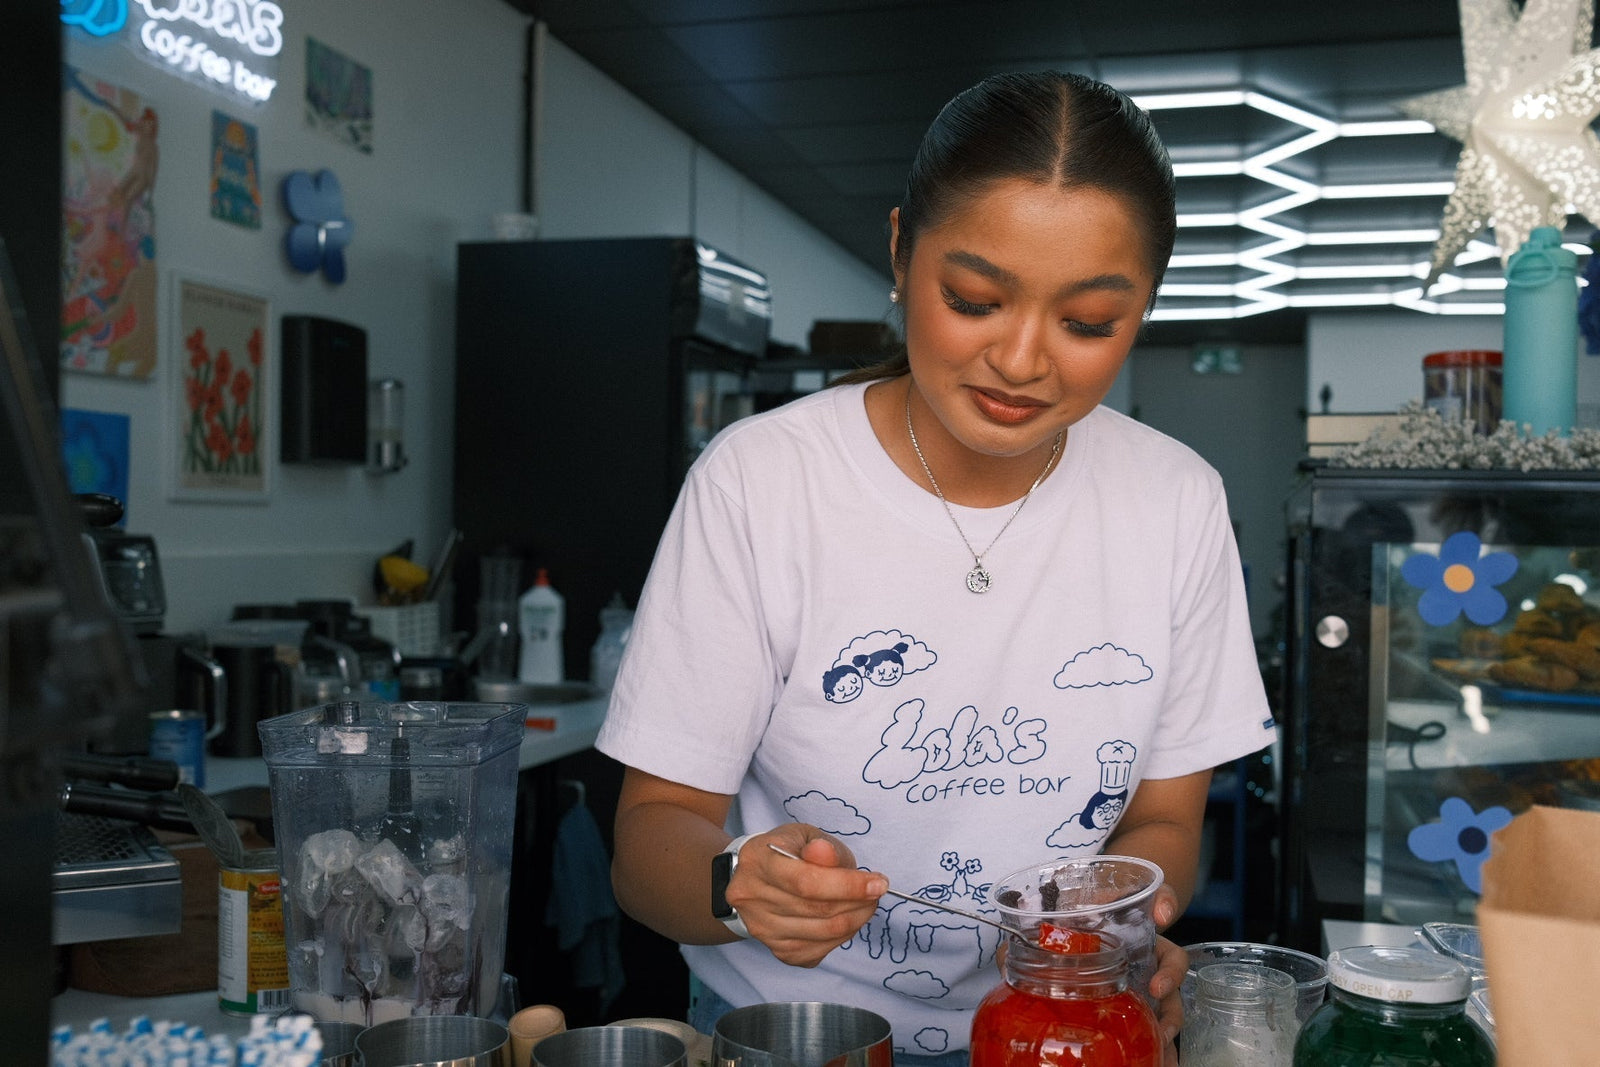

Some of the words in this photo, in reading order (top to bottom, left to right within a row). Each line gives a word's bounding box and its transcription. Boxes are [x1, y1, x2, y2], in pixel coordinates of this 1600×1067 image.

[141, 20, 232, 84] coffee
[234, 61, 277, 101] bar
[862, 698, 1047, 790] Lola's
[906, 774, 1005, 803] coffee
[1019, 773, 1071, 796] bar
[1352, 981, 1383, 997] OPEN
[1387, 988, 1413, 1000] CAP
